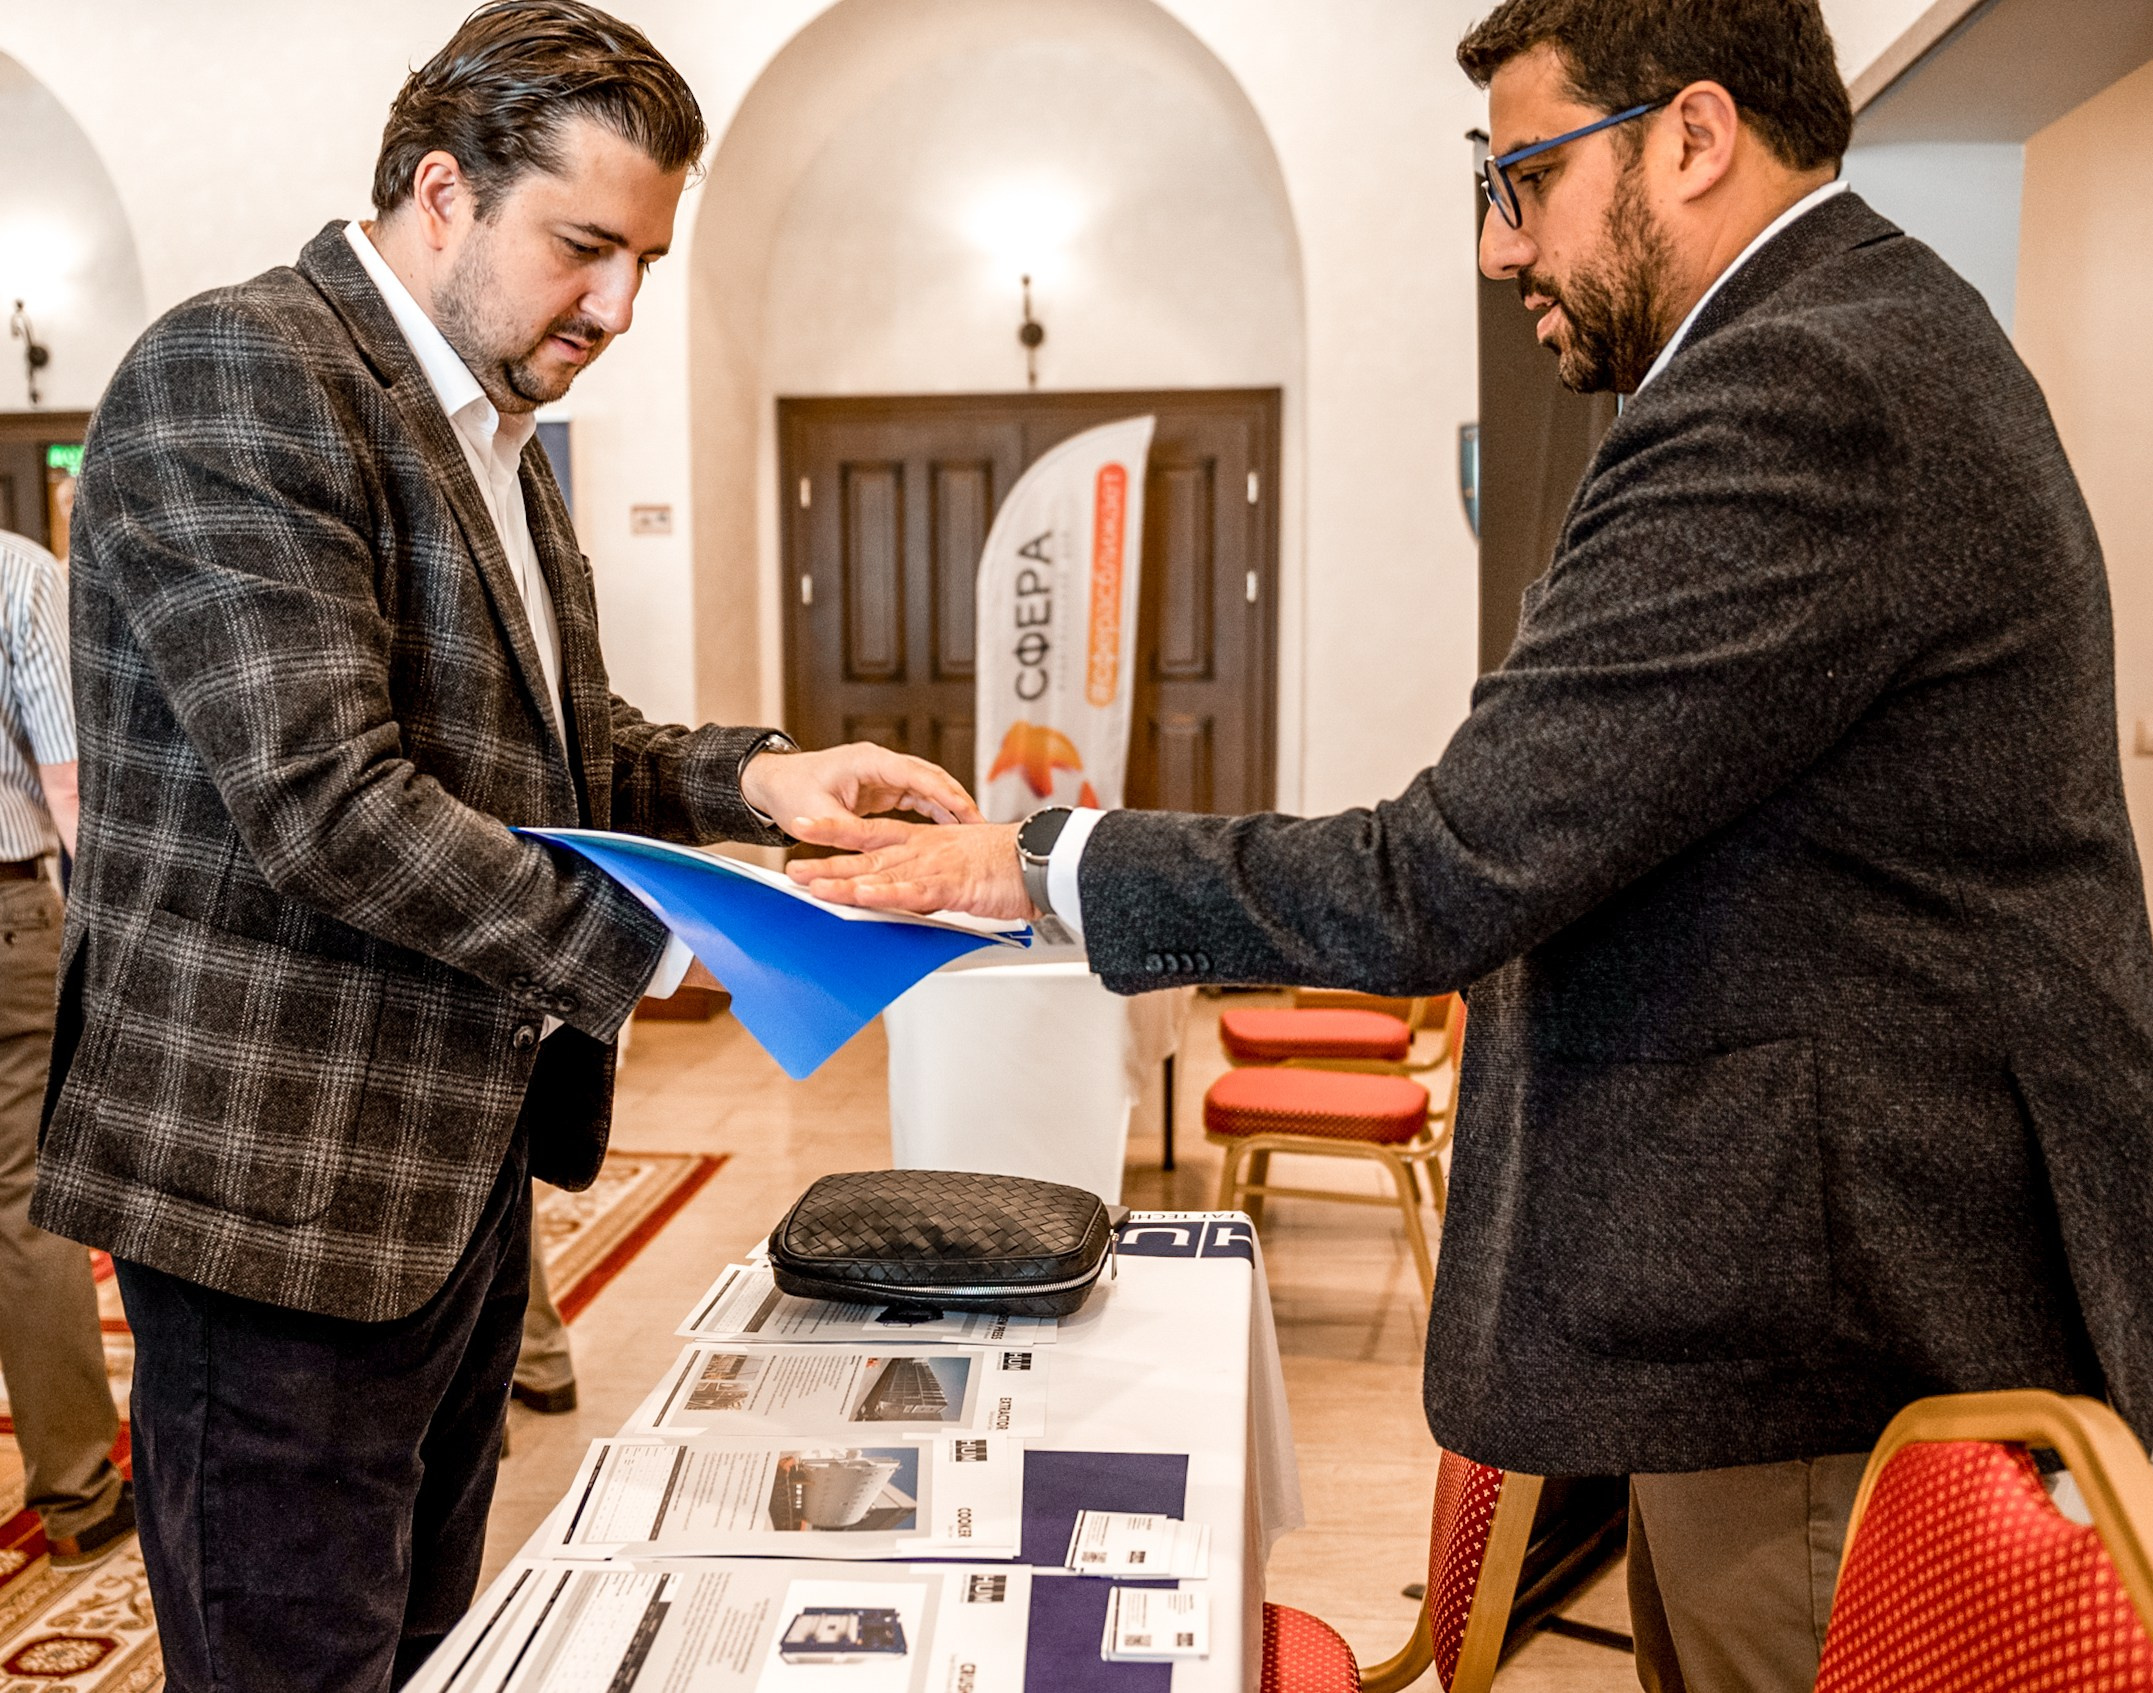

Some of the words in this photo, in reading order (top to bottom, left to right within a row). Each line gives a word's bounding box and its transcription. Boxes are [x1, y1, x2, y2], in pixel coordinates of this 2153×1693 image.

[1012, 530, 1052, 702] СФЕРА
[996, 1397, 1013, 1430] EXTRACTOR
[957, 1507, 972, 1538] COOKER
